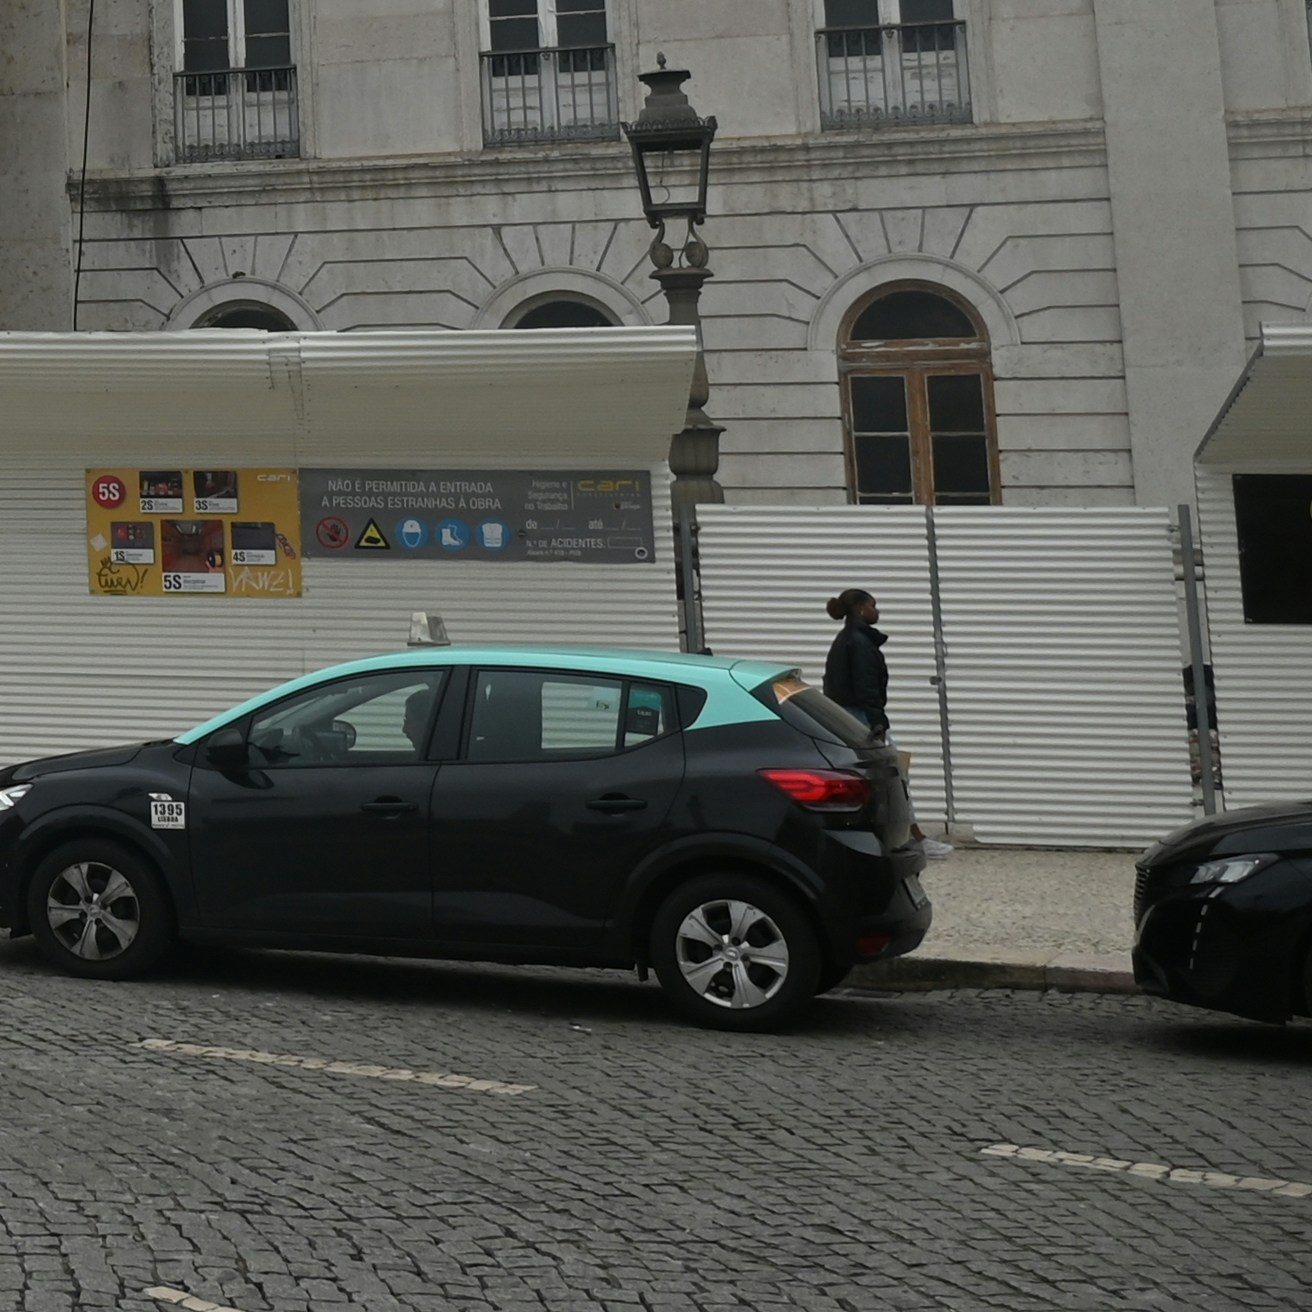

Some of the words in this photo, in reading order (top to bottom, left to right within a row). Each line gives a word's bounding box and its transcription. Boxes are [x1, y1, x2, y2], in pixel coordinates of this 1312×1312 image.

[328, 478, 352, 492] NÃO
[365, 480, 426, 493] PERMITIDA
[429, 481, 437, 493] A
[440, 481, 493, 494] ENTRADA
[578, 480, 640, 491] cari
[98, 483, 120, 501] 5S
[141, 500, 154, 511] 2S
[195, 500, 209, 511] 3S
[321, 495, 330, 507] A
[333, 495, 384, 508] PESSOAS
[387, 496, 455, 509] ESTRANHAS
[469, 497, 502, 509] OBRA
[114, 550, 125, 562] 1S
[233, 551, 246, 562] 4S
[163, 574, 182, 590] 5S
[153, 804, 182, 816] 1395
